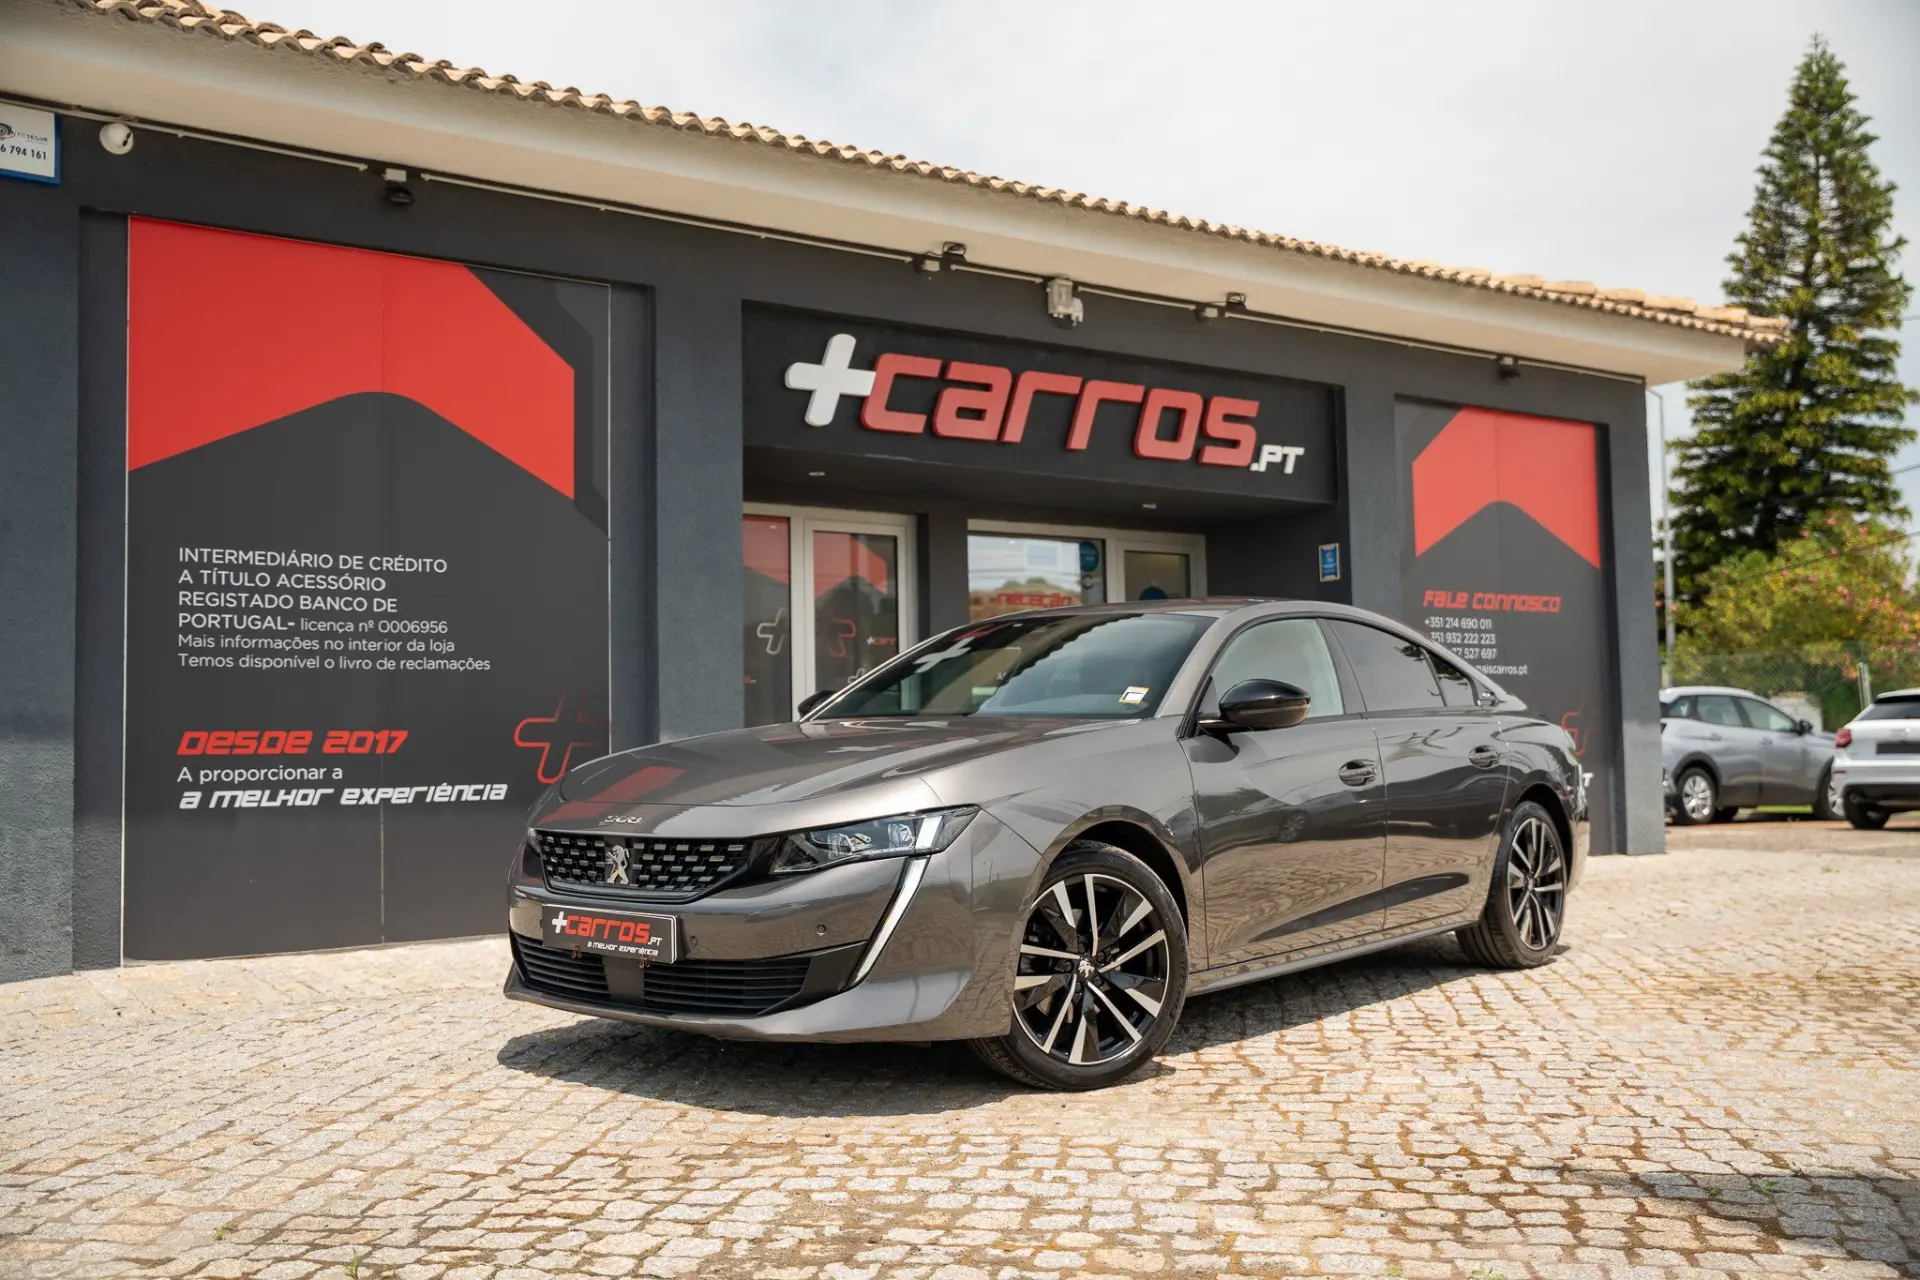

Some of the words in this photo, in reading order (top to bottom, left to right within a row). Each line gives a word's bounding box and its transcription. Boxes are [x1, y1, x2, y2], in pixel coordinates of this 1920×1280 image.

[10, 145, 27, 156] 794
[31, 149, 47, 160] 161
[178, 547, 333, 569] INTERMEDIÁRIO
[338, 554, 364, 570] DE
[368, 554, 448, 574] CRÉDITO
[178, 569, 194, 585] A
[199, 567, 271, 588] TÍTULO
[275, 573, 387, 592] ACESSÓRIO
[178, 591, 294, 609] REGISTADO
[299, 595, 368, 612] BANCO
[373, 597, 398, 613] DE
[178, 613, 296, 631] PORTUGAL-
[300, 617, 354, 635] licença
[378, 620, 448, 634] 0006956
[1424, 616, 1444, 628] +351
[1445, 617, 1459, 629] 214
[1460, 618, 1478, 630] 690
[1479, 618, 1492, 630] 011
[178, 633, 215, 648] Mais
[220, 634, 320, 653] informações
[324, 640, 344, 651] no
[348, 637, 403, 652] interior
[407, 637, 425, 652] da
[429, 638, 455, 655] loja
[1430, 632, 1444, 644] 351
[1446, 632, 1461, 644] 932
[1463, 633, 1479, 644] 222
[178, 653, 234, 668] Temos
[238, 654, 320, 671] disponível
[324, 658, 335, 669] o
[339, 656, 372, 670] livro
[376, 656, 396, 670] de
[400, 657, 491, 673] reclamações
[1464, 648, 1480, 659] 527
[1481, 648, 1497, 660] 697
[322, 729, 409, 754] 2017
[177, 766, 193, 783] A
[199, 765, 327, 785] proporcionar
[331, 767, 343, 779] a
